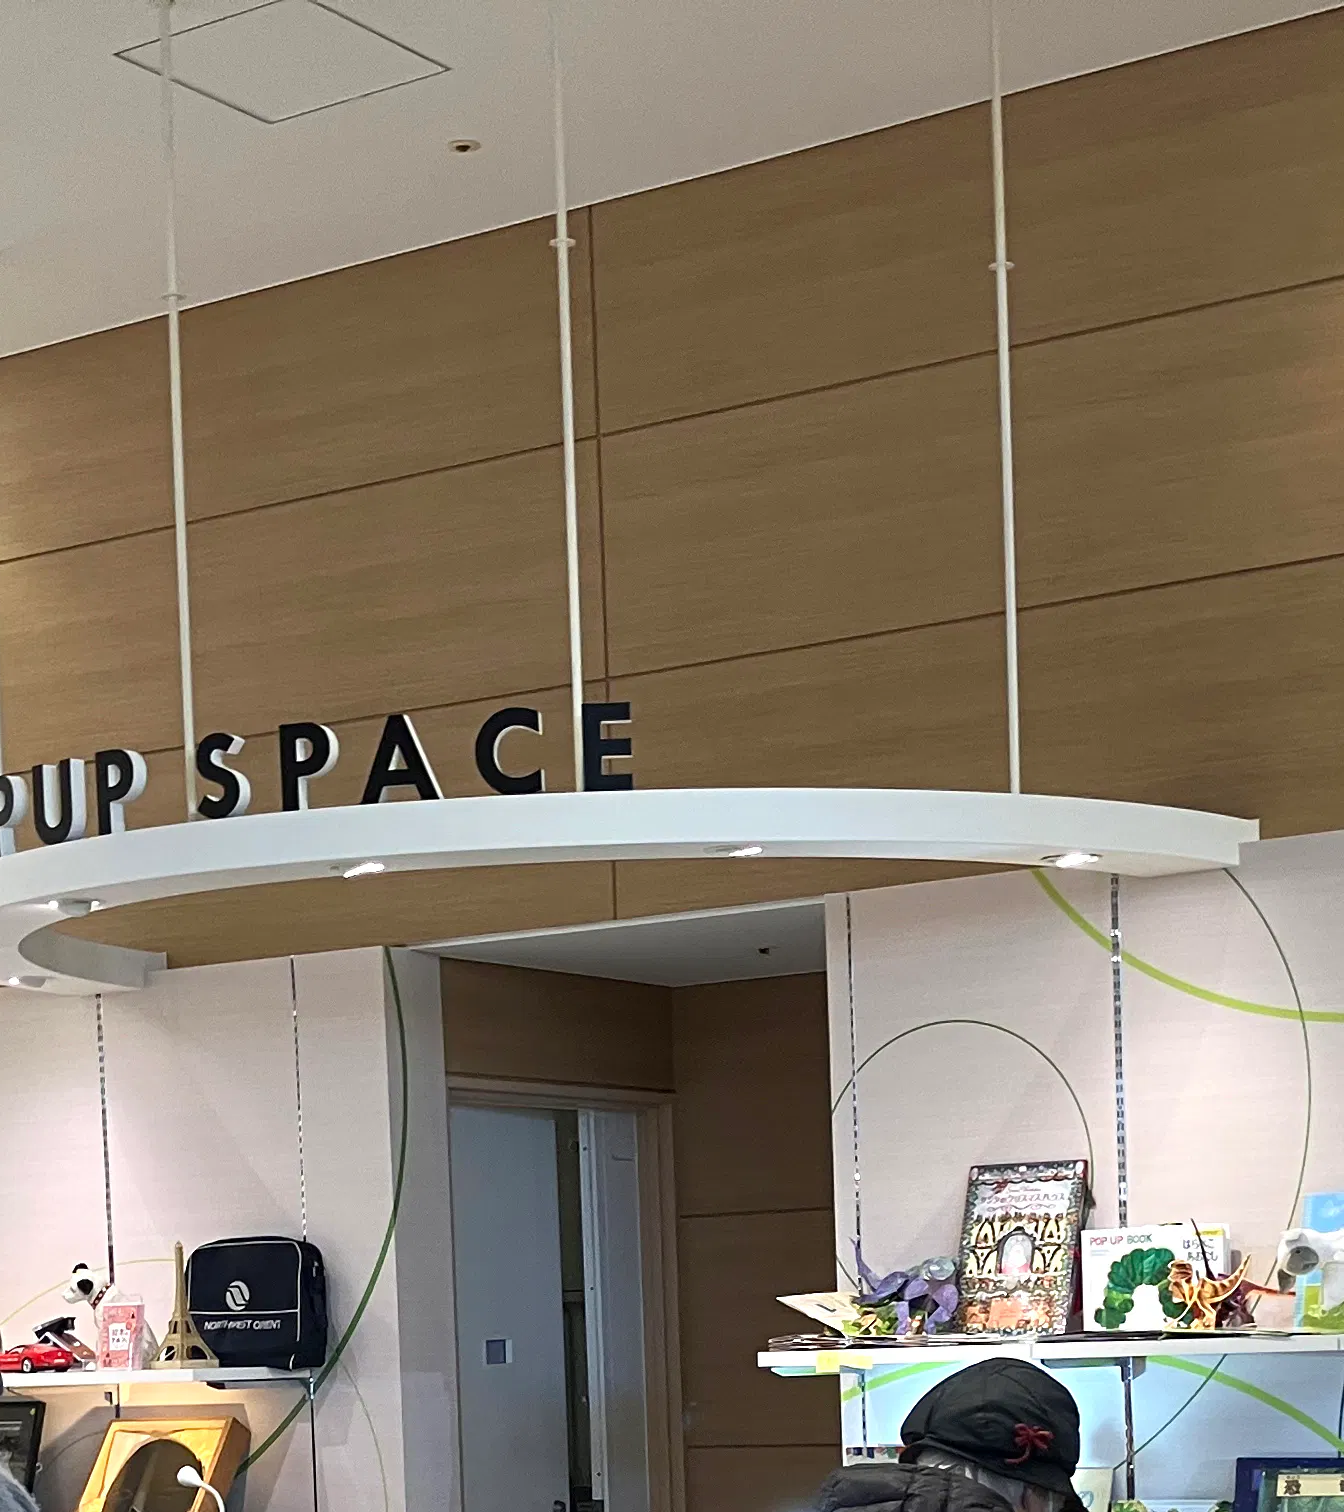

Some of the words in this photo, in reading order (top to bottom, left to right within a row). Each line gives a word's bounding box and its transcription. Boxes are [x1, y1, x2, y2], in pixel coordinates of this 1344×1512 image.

[196, 702, 634, 819] SPACE
[1089, 1236, 1107, 1246] POP
[1110, 1236, 1123, 1245] UP
[1127, 1233, 1153, 1244] BOOK
